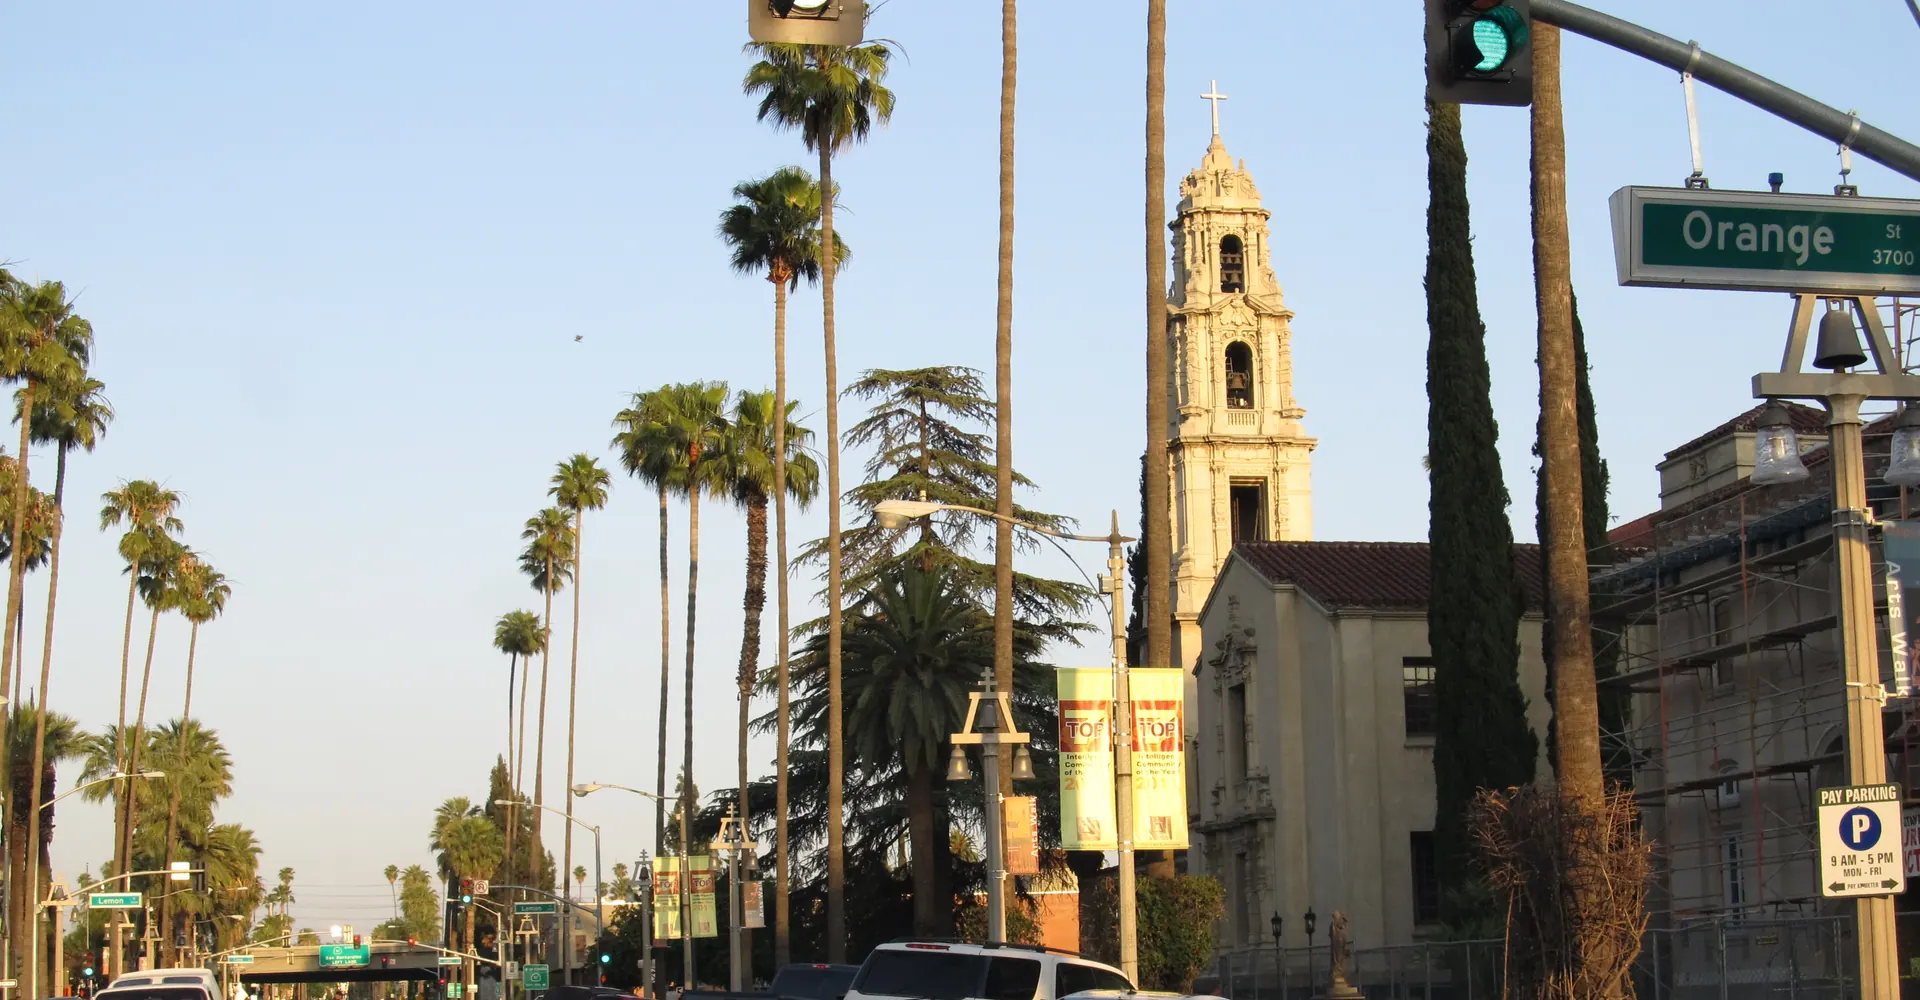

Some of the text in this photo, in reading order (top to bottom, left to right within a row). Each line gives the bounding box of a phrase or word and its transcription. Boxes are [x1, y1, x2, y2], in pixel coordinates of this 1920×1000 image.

[1683, 210, 1835, 266] Orange
[1886, 224, 1901, 239] St
[1872, 249, 1914, 266] 3700
[1886, 560, 1902, 619] Arts
[1891, 631, 1912, 698] Walk
[1066, 722, 1104, 738] TOP
[1140, 722, 1175, 738] TOP
[1821, 786, 1897, 805] PAY PARKING
[1029, 796, 1039, 857] Arts Walk
[1852, 814, 1870, 843] P
[1831, 855, 1837, 866] 9
[1840, 854, 1857, 866] AM
[1867, 853, 1874, 865] 5
[1877, 852, 1893, 864] PM
[1843, 868, 1862, 877] MON
[1869, 867, 1882, 875] FRI
